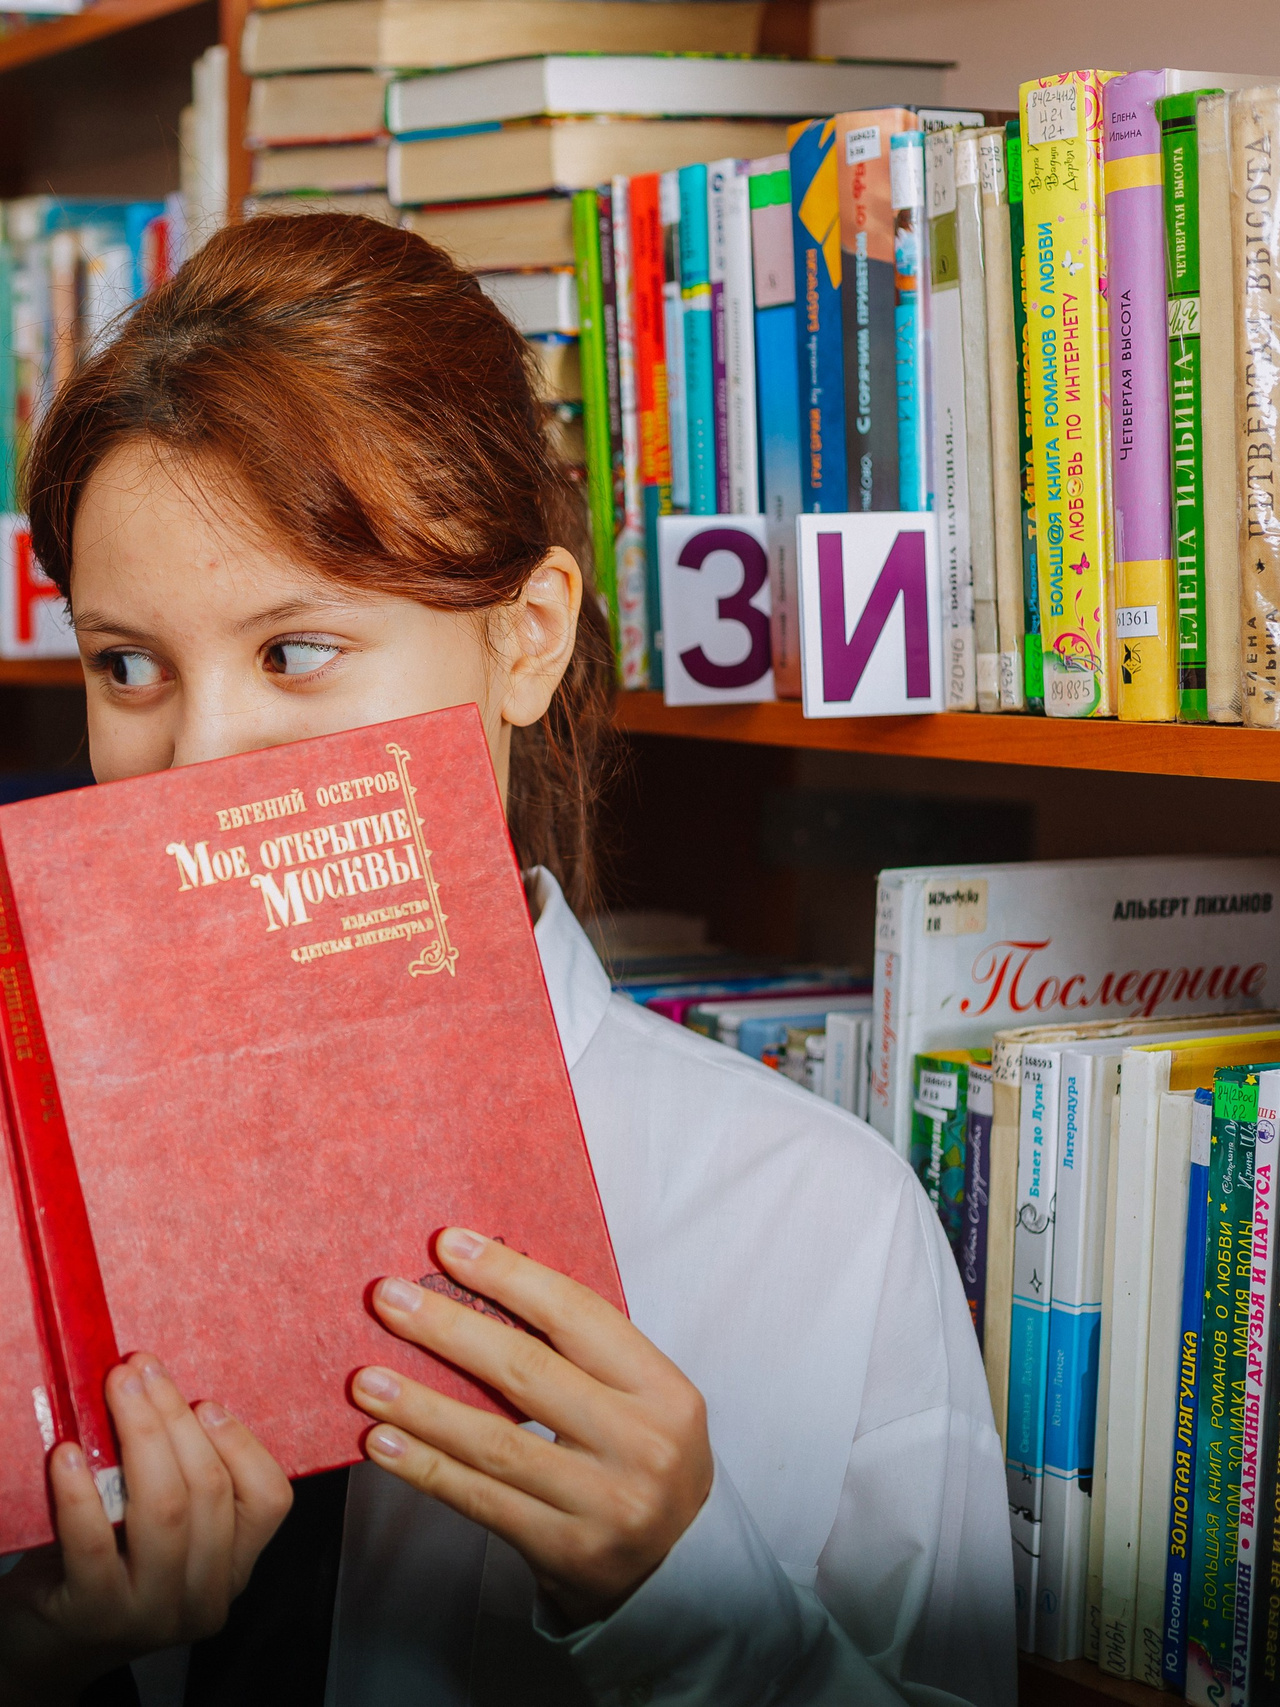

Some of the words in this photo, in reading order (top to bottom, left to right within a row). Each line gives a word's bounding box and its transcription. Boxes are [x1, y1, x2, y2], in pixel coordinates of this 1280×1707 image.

[1173, 147, 1185, 199] ВЫСОТА
[1175, 203, 1186, 279] ЧЕТВЕРТАЯ
[1244, 133, 1273, 295] ВЫСОТА
[1038, 221, 1055, 294] ЛЮБВИ
[1040, 304, 1056, 319] О
[1062, 292, 1080, 403] ИНТЕРНЕТУ
[1120, 289, 1132, 361] ВЫСОТА
[1042, 329, 1060, 428] РОМАНОВ
[1065, 413, 1082, 440] ПО
[1174, 350, 1196, 508] ИЛЬИНА
[1045, 437, 1062, 502] КНИГА
[817, 530, 931, 702] И
[1178, 527, 1198, 652] ЕЛЕНА
[1246, 616, 1257, 697] ЕЛЕНА
[215, 787, 308, 832] ЕВГЕНИЙ
[315, 770, 400, 808] ОСЕТРОВ
[259, 807, 413, 870] ОТКРЫТИЕ
[339, 898, 431, 932] ИЗДАТЕЛЬСТВО
[1113, 897, 1190, 921] АЛЬБЕРТ
[1194, 892, 1274, 916] ЛИХАНОВ
[959, 935, 1268, 1018] Последние
[1032, 1126, 1044, 1147] до
[1063, 1076, 1078, 1170] Литеродура
[1029, 1156, 1041, 1198] Билет
[1221, 1141, 1236, 1194] Светлана
[1237, 1151, 1254, 1190] Ирина
[1252, 1164, 1272, 1261] ПАРУСА
[1216, 1221, 1233, 1296] ЛЮБВИ
[1252, 1268, 1266, 1286] И
[1215, 1304, 1229, 1320] О
[1247, 1291, 1265, 1387] ДРУЗЬЯ
[1177, 1330, 1198, 1448] ЛЯГУШКА
[1210, 1329, 1228, 1429] РОМАНОВ
[1224, 1483, 1241, 1567] ЗНАКОМ
[1233, 1289, 1250, 1358] МАГИЯ
[1240, 1391, 1261, 1529] ВАЛЬКИНЫ
[1171, 1450, 1192, 1560] ЗОЛОТАЯ
[1207, 1440, 1223, 1504] КНИГА
[1203, 1512, 1220, 1611] БОЛЬШАЯ
[1166, 1571, 1182, 1644] Леонов
[1232, 1560, 1252, 1692] КРАПИВИН
[1165, 1646, 1178, 1673] Ю.
